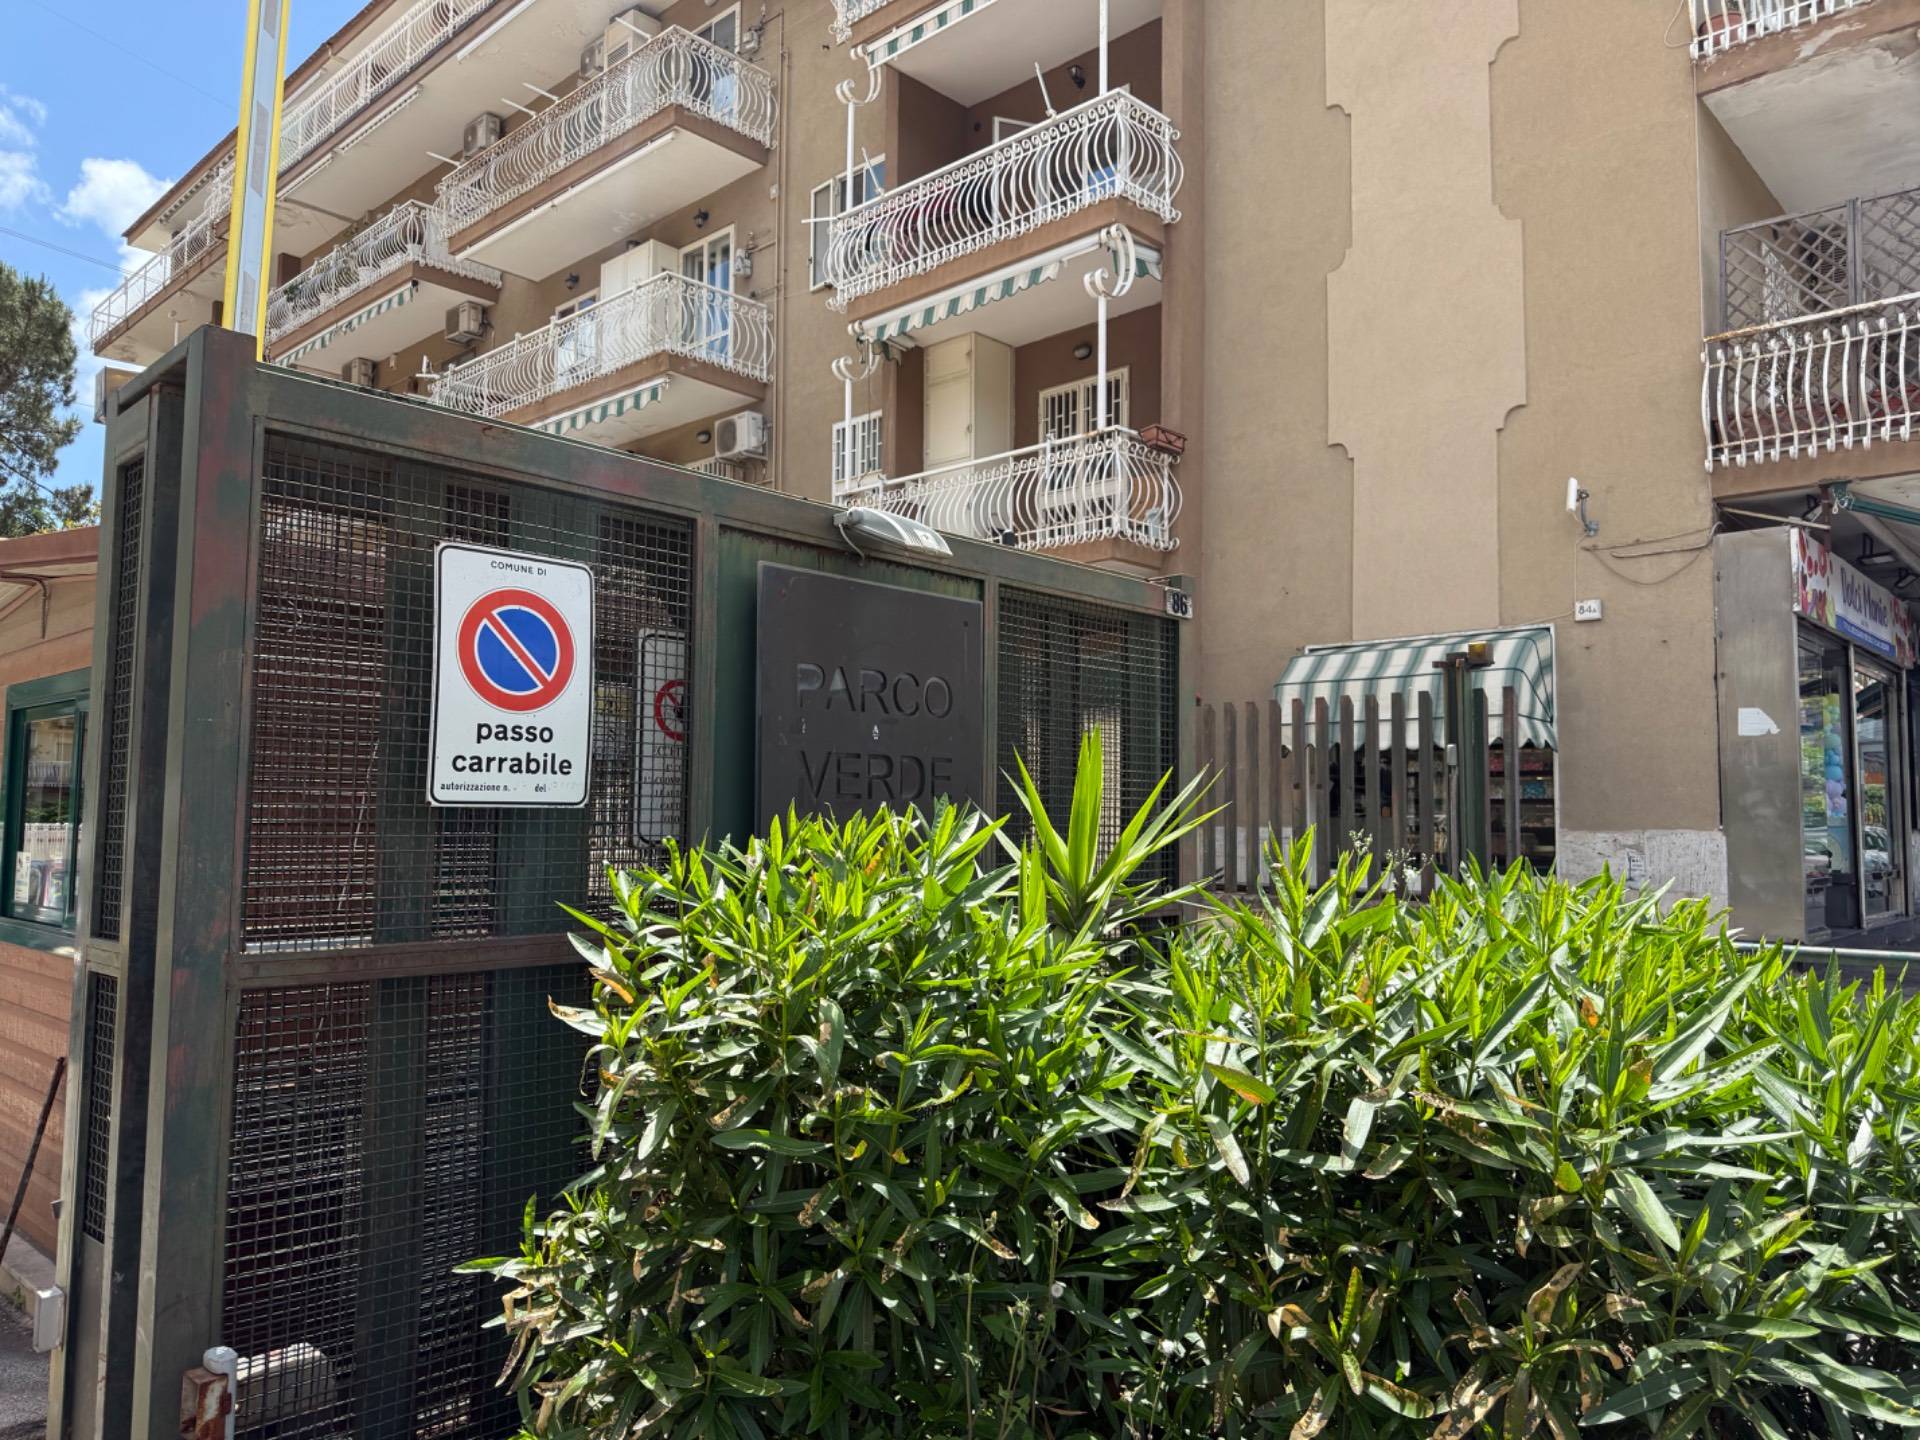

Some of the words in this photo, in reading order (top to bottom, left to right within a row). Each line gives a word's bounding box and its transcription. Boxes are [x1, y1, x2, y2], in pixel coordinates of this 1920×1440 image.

[490, 560, 534, 575] COMUNE
[537, 568, 547, 576] DI
[1172, 592, 1187, 616] 86
[796, 663, 953, 719] PARCO
[476, 722, 554, 744] passo
[452, 752, 573, 775] carrabile
[440, 782, 500, 792] autorizzazione
[534, 784, 547, 793] del
[800, 751, 953, 801] VERDE
